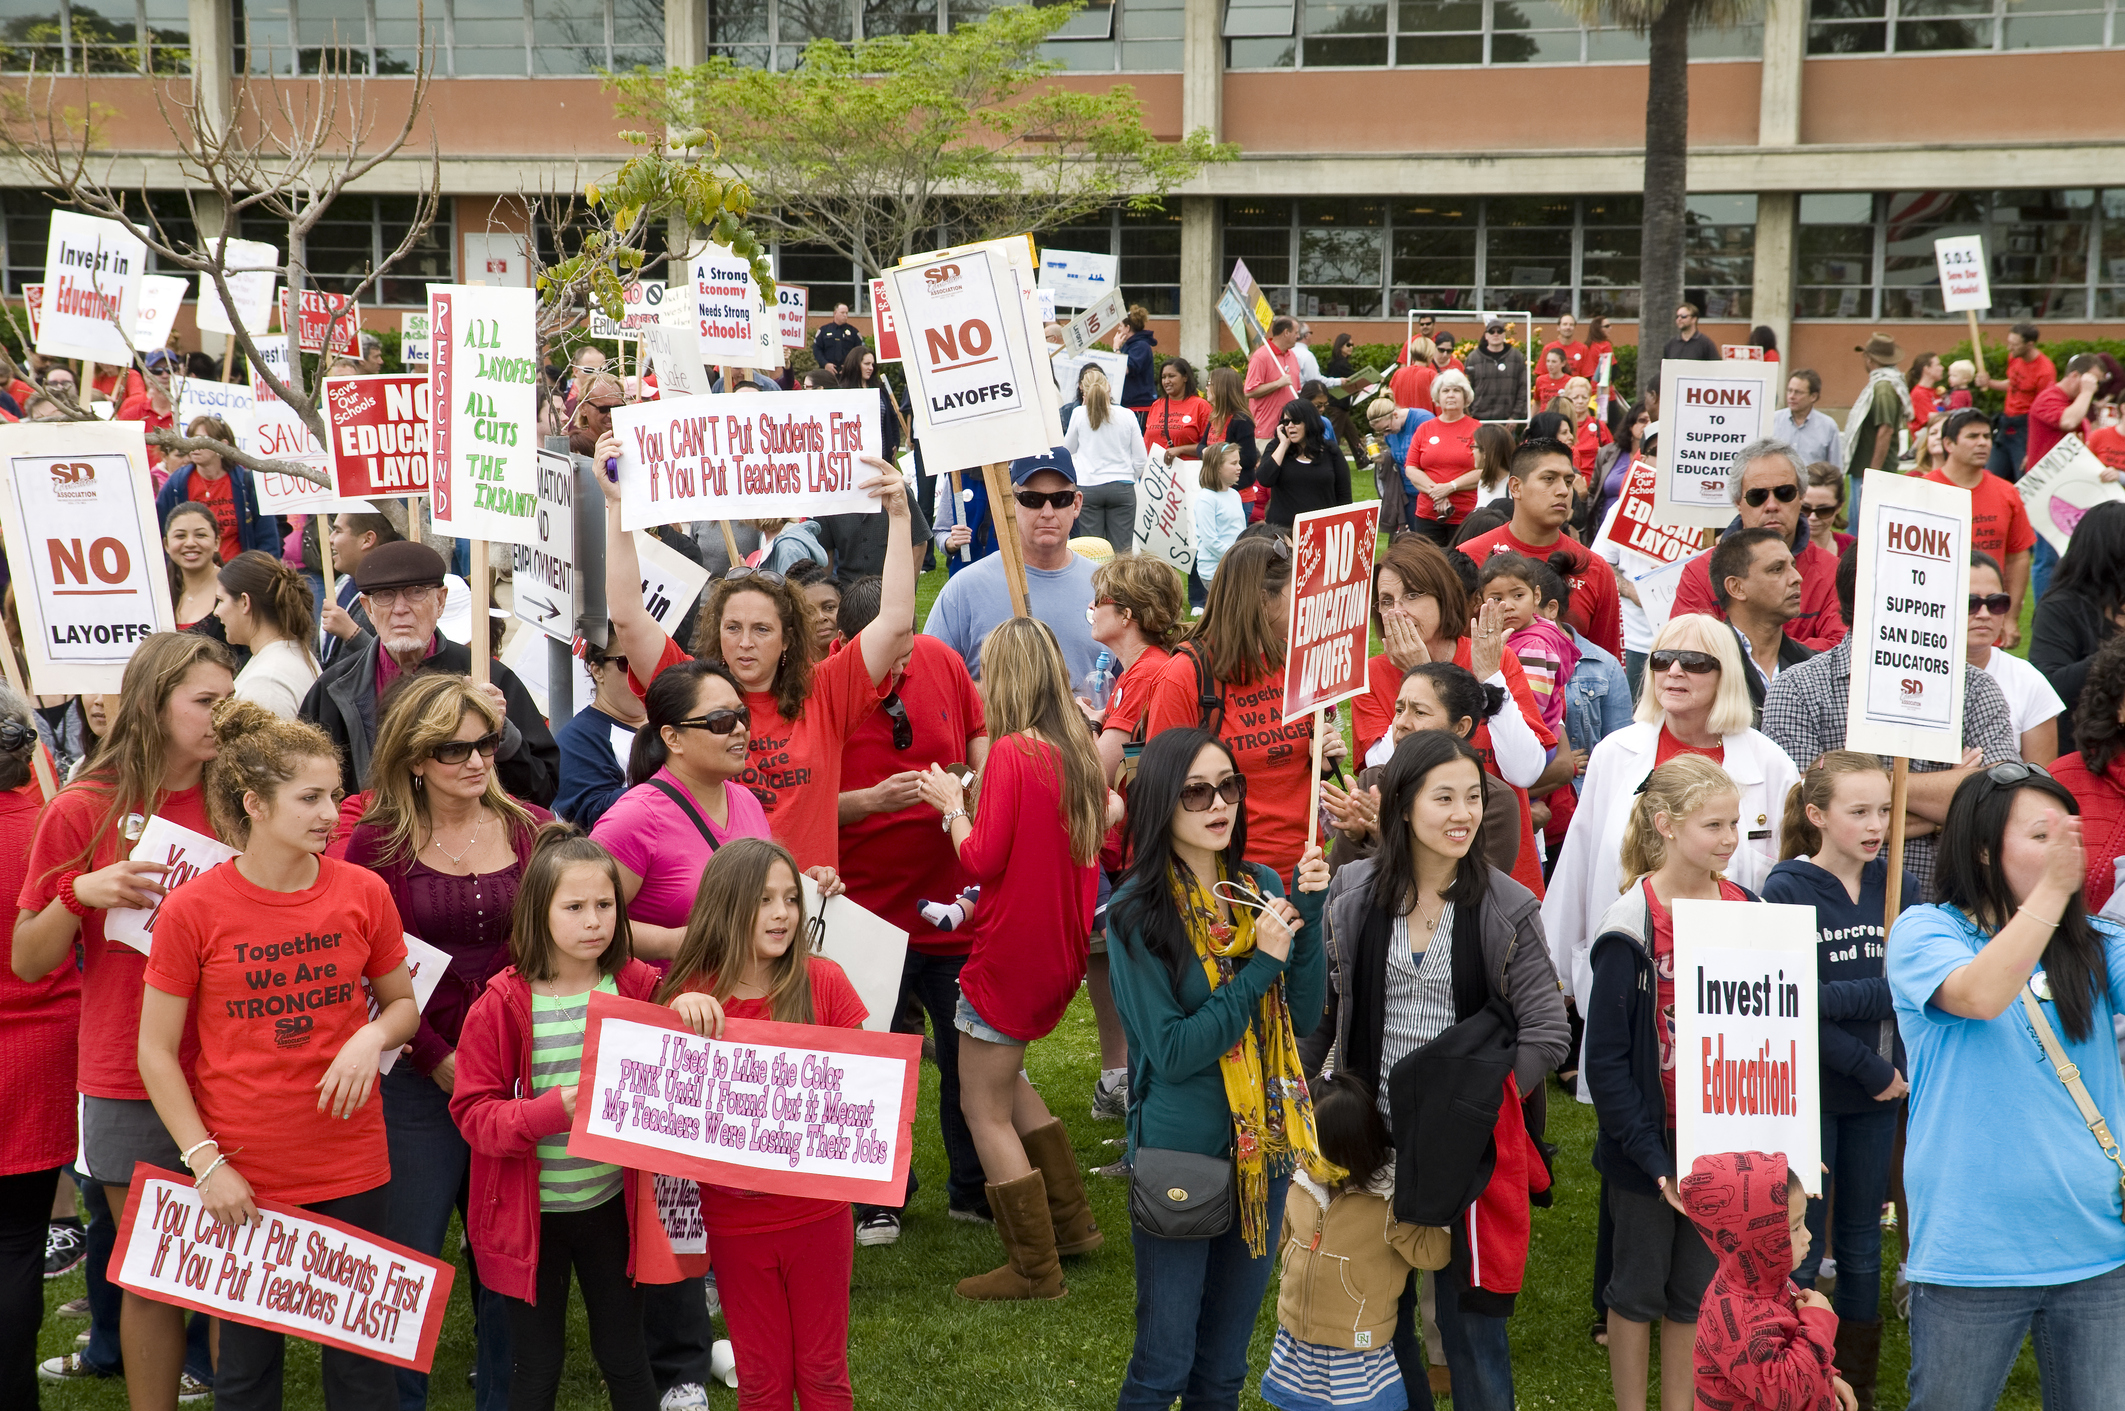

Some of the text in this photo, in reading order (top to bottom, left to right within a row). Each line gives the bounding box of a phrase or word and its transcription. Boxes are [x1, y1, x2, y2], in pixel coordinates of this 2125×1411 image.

[59, 240, 129, 275] Invest in
[697, 267, 748, 284] A Strong
[924, 264, 961, 284] SD
[56, 274, 123, 323] Education!
[299, 295, 339, 315] KEEP
[699, 282, 746, 299] Economy
[699, 302, 722, 318] Needs
[724, 305, 750, 322] Strong
[789, 313, 803, 323] Our
[1086, 312, 1101, 334] NO
[464, 319, 501, 349] ALL
[648, 330, 672, 356] HOW
[700, 319, 752, 341] Schools!
[924, 318, 993, 366] NO
[475, 353, 536, 384] LAYOFFS
[663, 360, 690, 390] Safe
[178, 380, 253, 410] Preschoo
[329, 381, 358, 401] Save
[337, 391, 360, 410] Our
[464, 391, 498, 418] ALL
[931, 382, 1014, 412] LAYOFFS
[1686, 388, 1752, 406] HONK
[333, 396, 377, 426] Schools
[434, 300, 450, 515] RESCIND
[1709, 416, 1725, 425] TO
[340, 424, 428, 457] EDUCA
[474, 418, 519, 448] CUTS
[634, 411, 863, 465] You CAN'T Put Students First
[1686, 432, 1746, 443] SUPPORT
[466, 454, 507, 482] THE
[1676, 464, 1731, 476] EDUCATO
[1680, 450, 1706, 460] SAN
[50, 462, 96, 484] SD
[367, 454, 428, 489] LAYO
[650, 451, 852, 502] If You Put Teachers LAST!
[1634, 470, 1656, 479] Save
[1635, 478, 1654, 488] Our
[1700, 481, 1725, 490] SD
[474, 483, 538, 518] INSANITY
[1158, 472, 1186, 538] HURT
[538, 509, 549, 542] ND
[1299, 522, 1314, 554] Save
[1888, 521, 1951, 558] HONK
[46, 536, 131, 585] NO
[1301, 541, 1316, 568] Our
[1323, 520, 1356, 587] NO
[513, 543, 572, 595] EMPLOYMENT
[1296, 547, 1322, 595] Schools
[1912, 569, 1926, 586] TO
[645, 583, 672, 623] in
[1295, 578, 1369, 648] EDUCATION
[1887, 596, 1946, 619] SUPPORT
[51, 624, 152, 645] LAYOFFS
[1880, 625, 1947, 650] SAN DIEGO
[1299, 633, 1354, 699] LAYOFFS
[1874, 650, 1950, 675] EDUCATORS
[1229, 685, 1284, 709] Togethe
[1901, 678, 1924, 695] SD
[1239, 711, 1267, 728] We
[758, 752, 790, 770] Are
[234, 931, 342, 963] Together
[1816, 924, 1885, 943] abercrom
[1829, 944, 1857, 963] and
[245, 961, 338, 991] We Are
[225, 980, 356, 1020] STRONGER!
[1697, 965, 1771, 1017] Invest
[1778, 968, 1799, 1018] in
[274, 1015, 314, 1033] SD
[659, 1034, 844, 1091] I Used to Like the Color
[1701, 1033, 1797, 1117] Education!
[618, 1058, 874, 1128] PINK Until I Found Out it Meant
[602, 1088, 888, 1168] My Teachers Were Losing Their Jobs
[153, 1186, 190, 1238] You
[262, 1219, 298, 1267] Put
[302, 1230, 378, 1296] Students
[380, 1261, 424, 1313] First
[150, 1233, 400, 1343] If You Put Teachers LAST!
